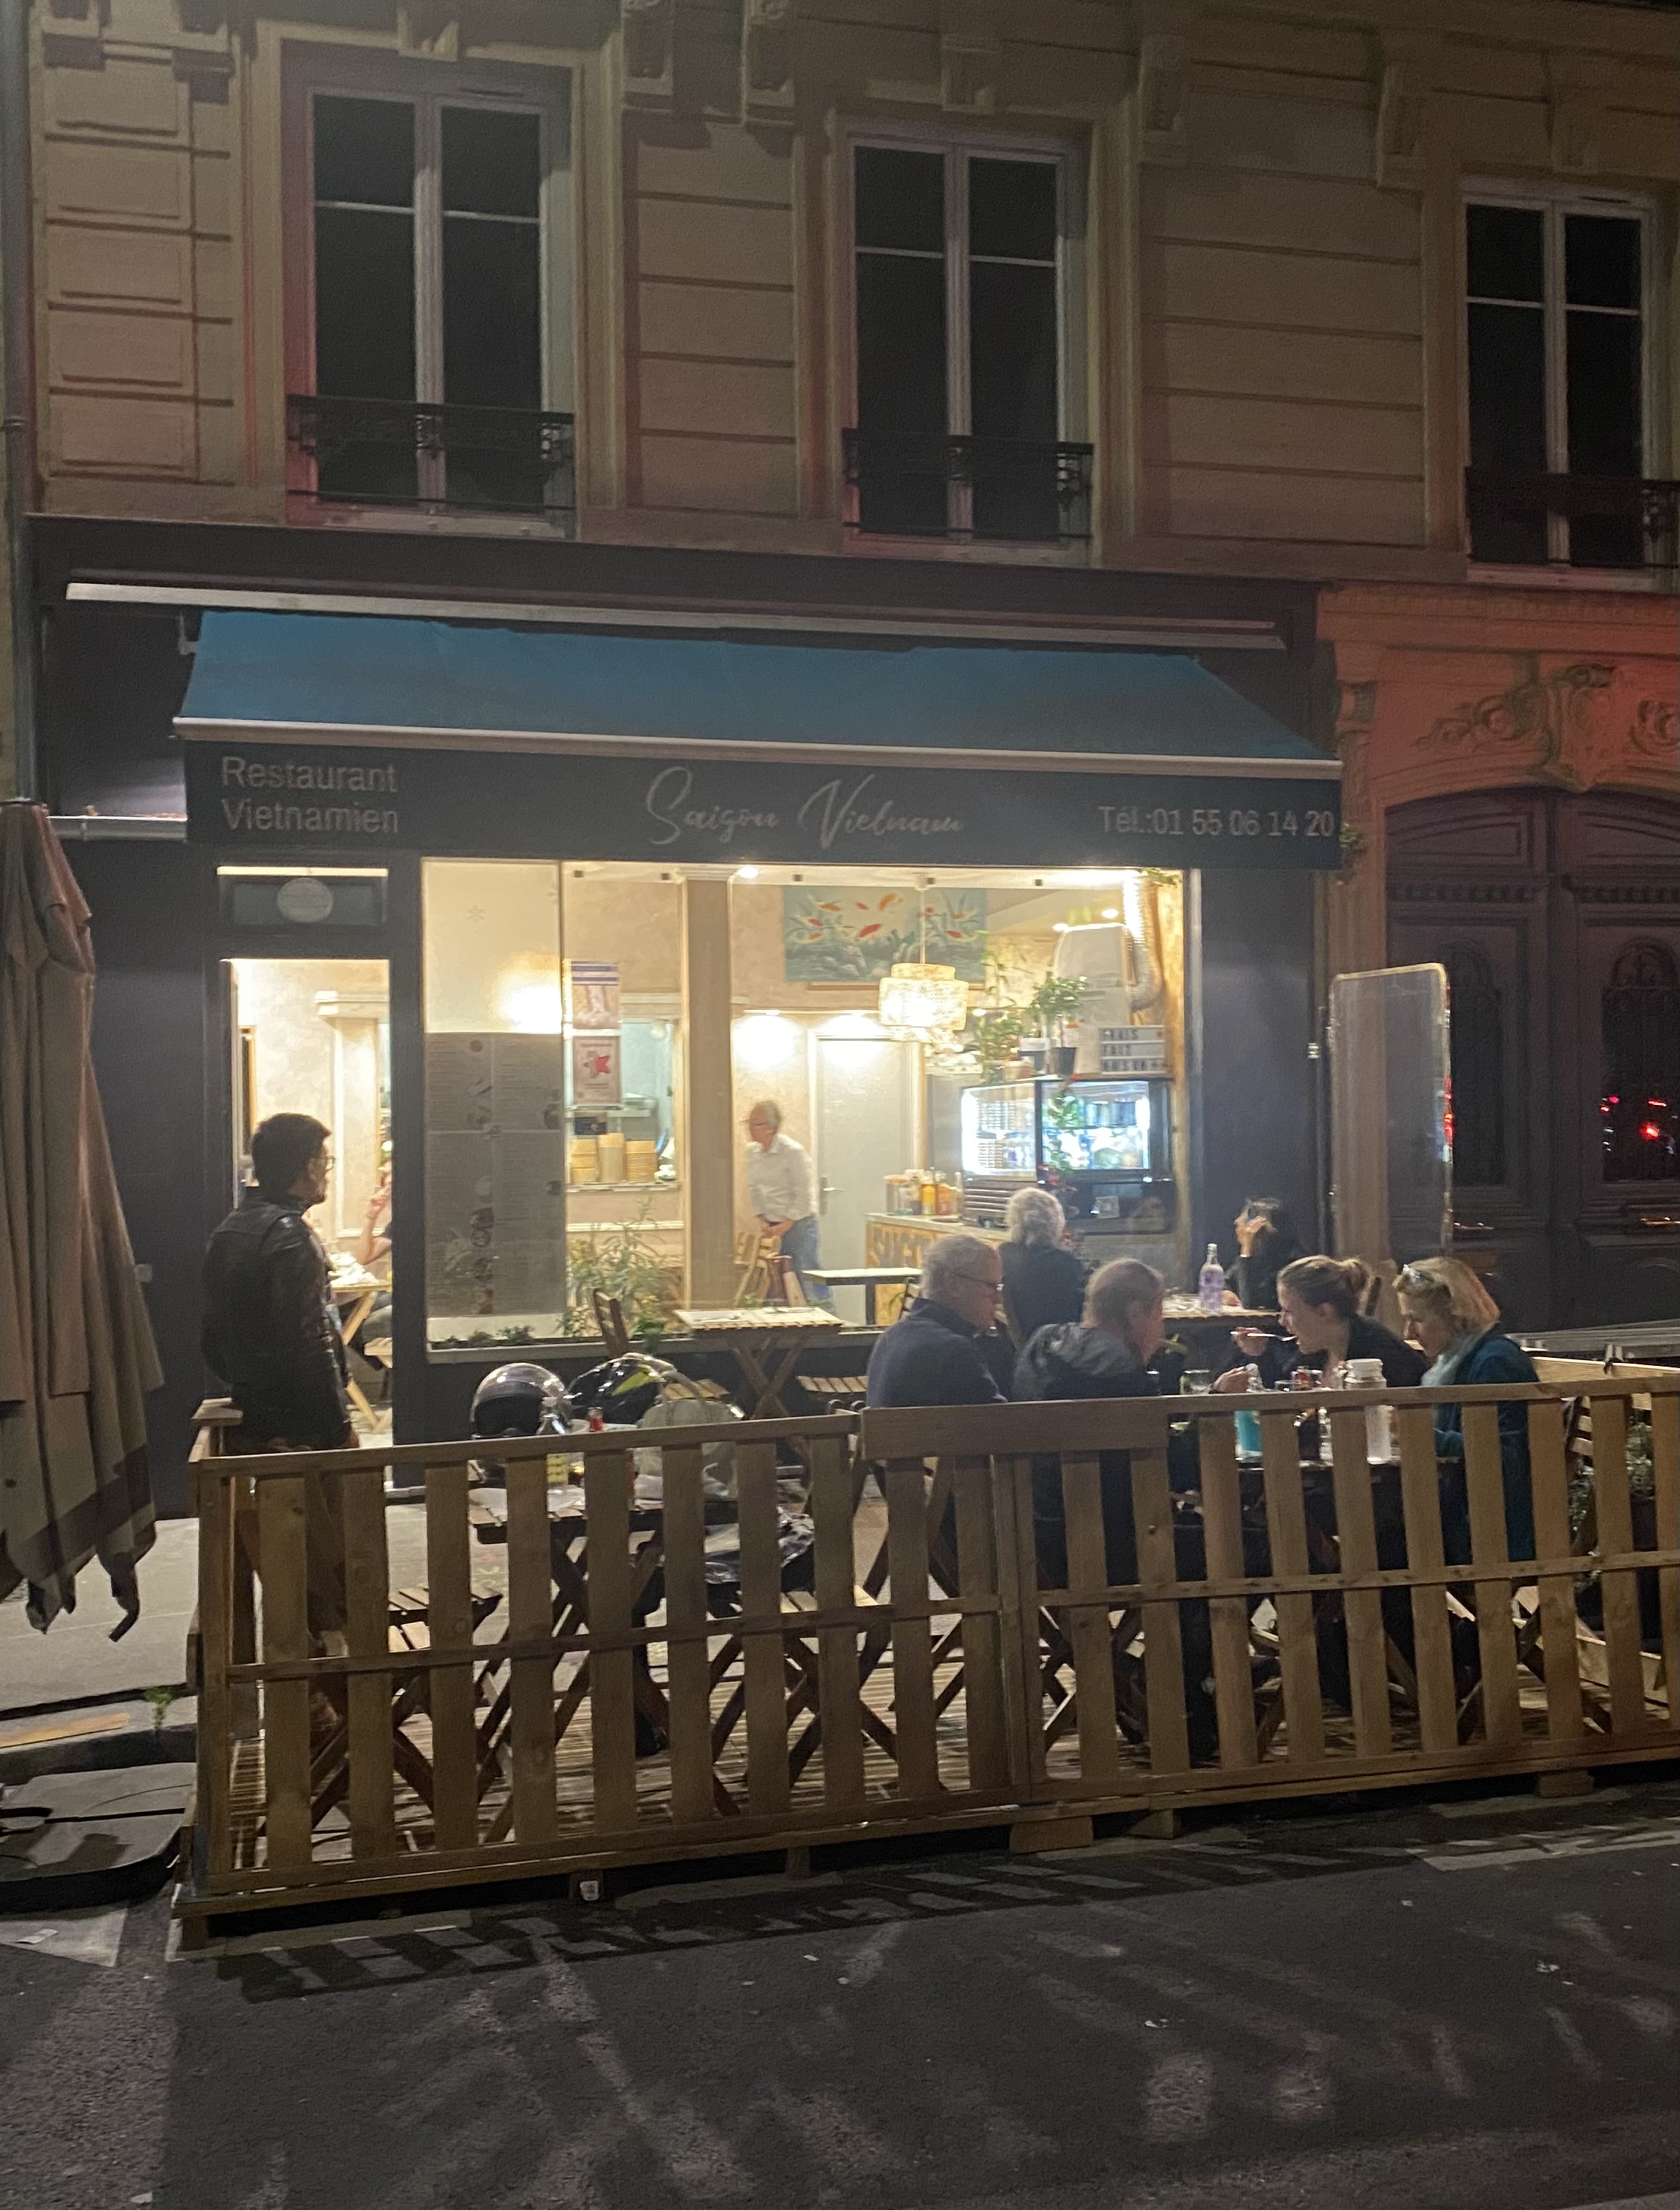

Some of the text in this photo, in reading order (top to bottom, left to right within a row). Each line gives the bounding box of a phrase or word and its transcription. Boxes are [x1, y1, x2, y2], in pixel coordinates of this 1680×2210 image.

[221, 756, 398, 792] Restaurant
[221, 797, 399, 833] Vietnamien
[646, 766, 781, 846] Saigon
[1192, 809, 1223, 836] 55
[1228, 809, 1261, 836] 06
[1269, 810, 1299, 837] 14
[1305, 810, 1336, 838] 20
